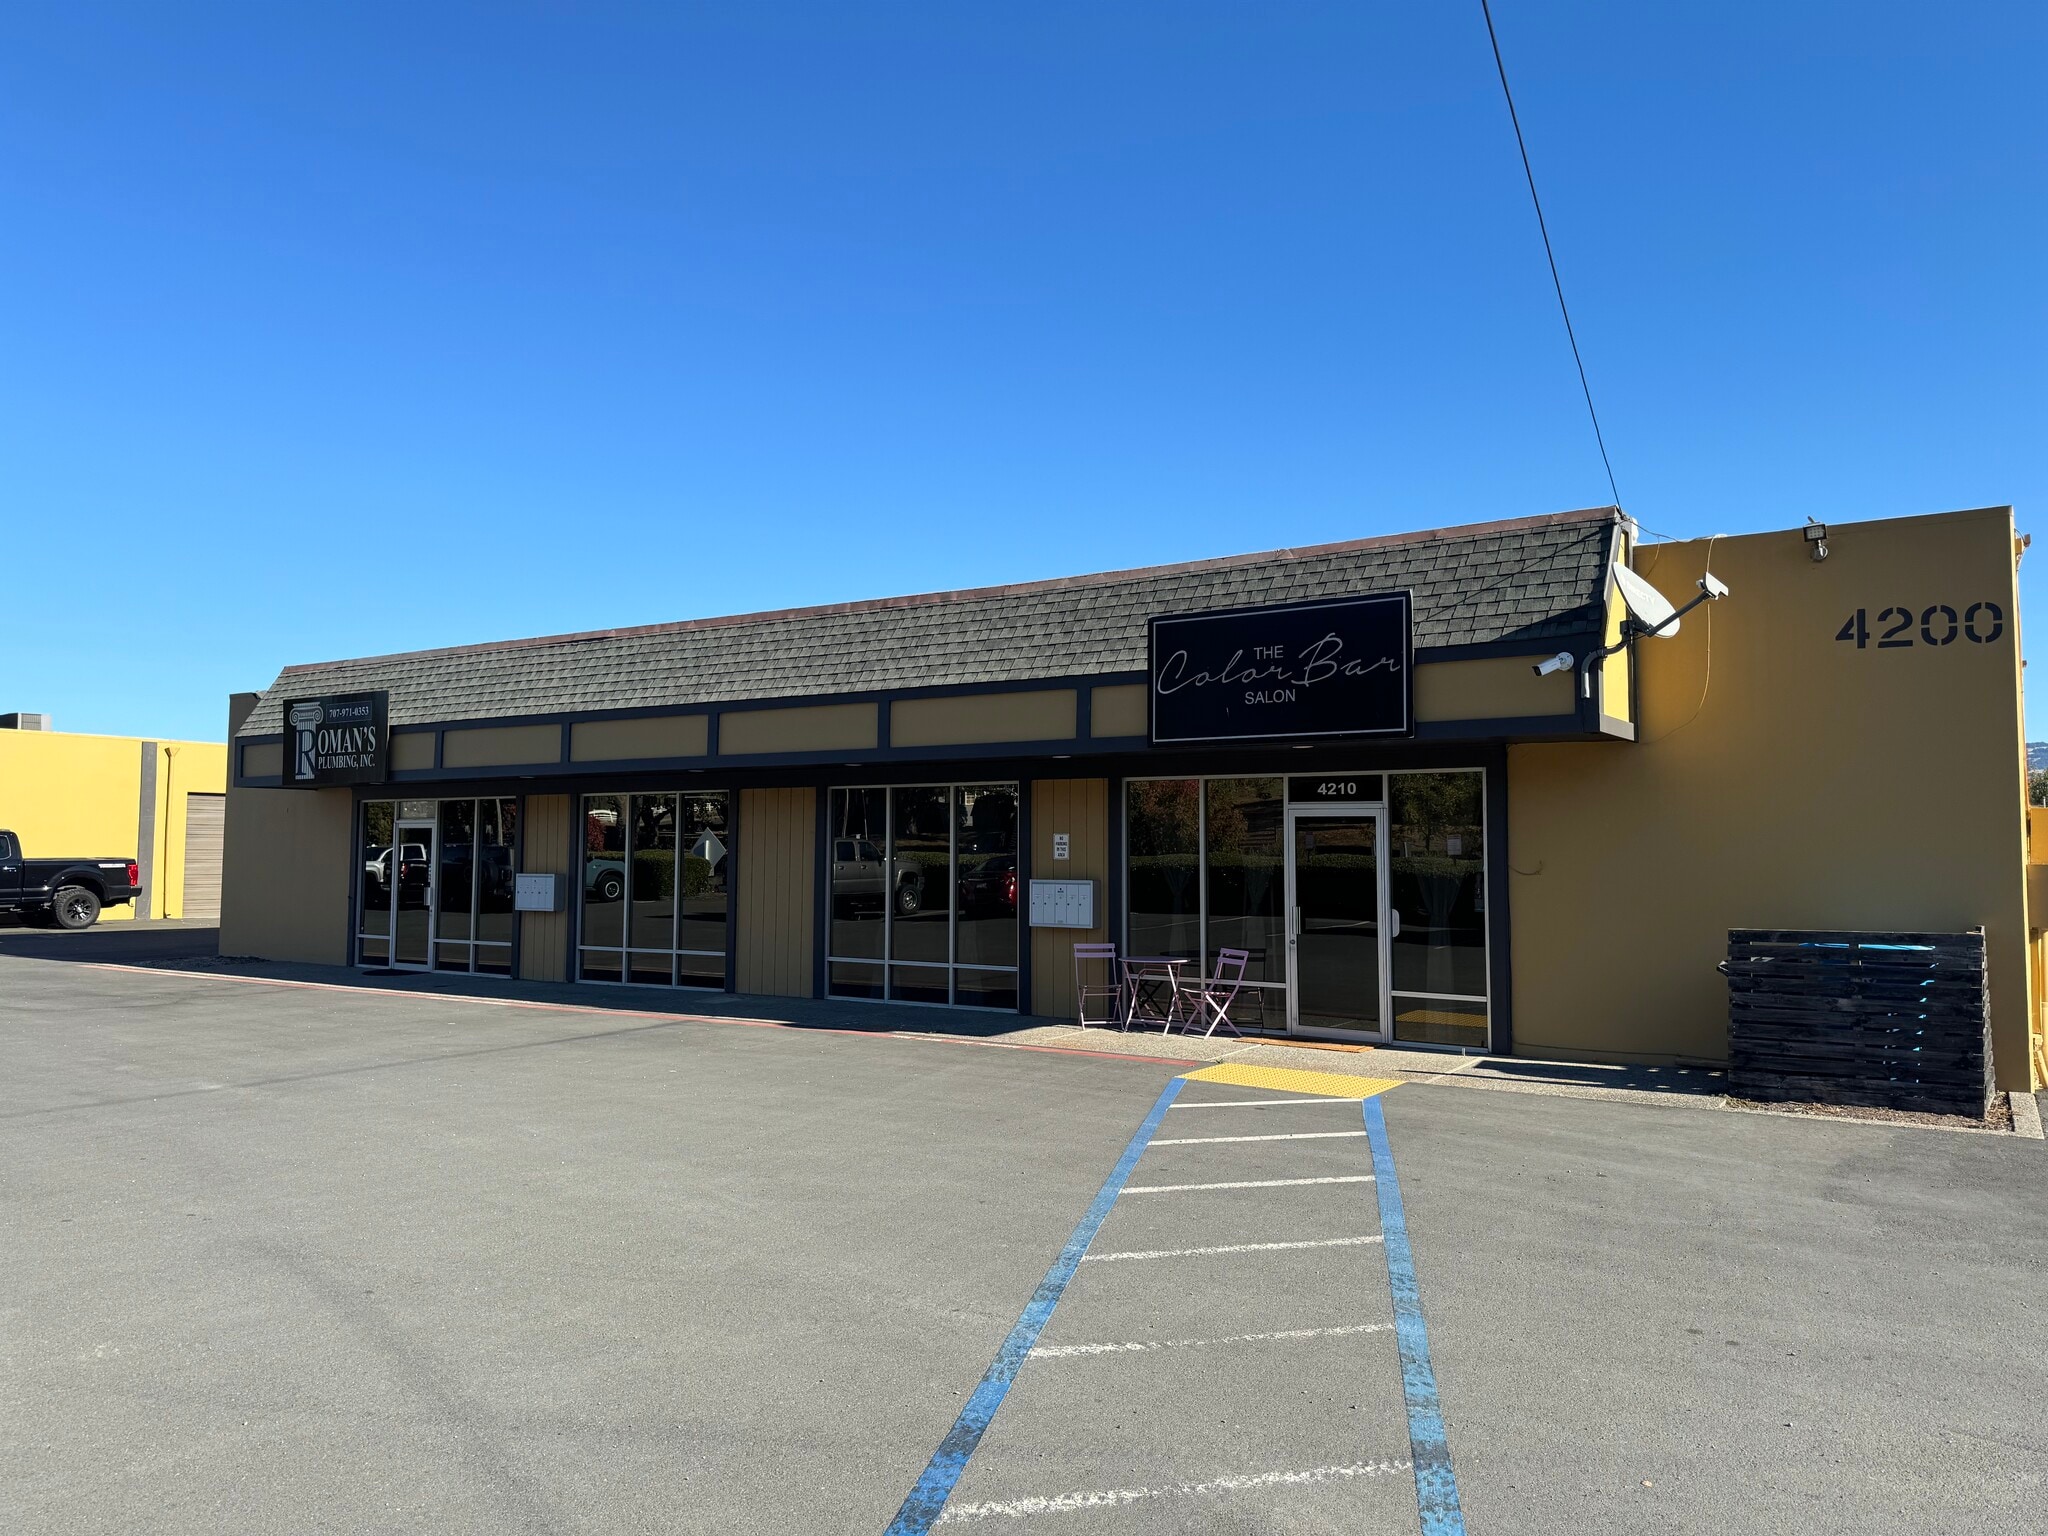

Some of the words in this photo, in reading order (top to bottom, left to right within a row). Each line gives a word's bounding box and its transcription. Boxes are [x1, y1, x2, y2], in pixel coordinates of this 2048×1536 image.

[1835, 601, 2003, 649] 4200
[1253, 645, 1284, 660] THE
[1157, 649, 1293, 695] Color
[1291, 632, 1401, 687] Bar
[1244, 689, 1296, 705] SALON
[329, 706, 369, 718] 707-971-0353
[318, 754, 359, 770] PLUMBING,
[360, 753, 376, 768] INC.
[1317, 782, 1357, 795] 4210
